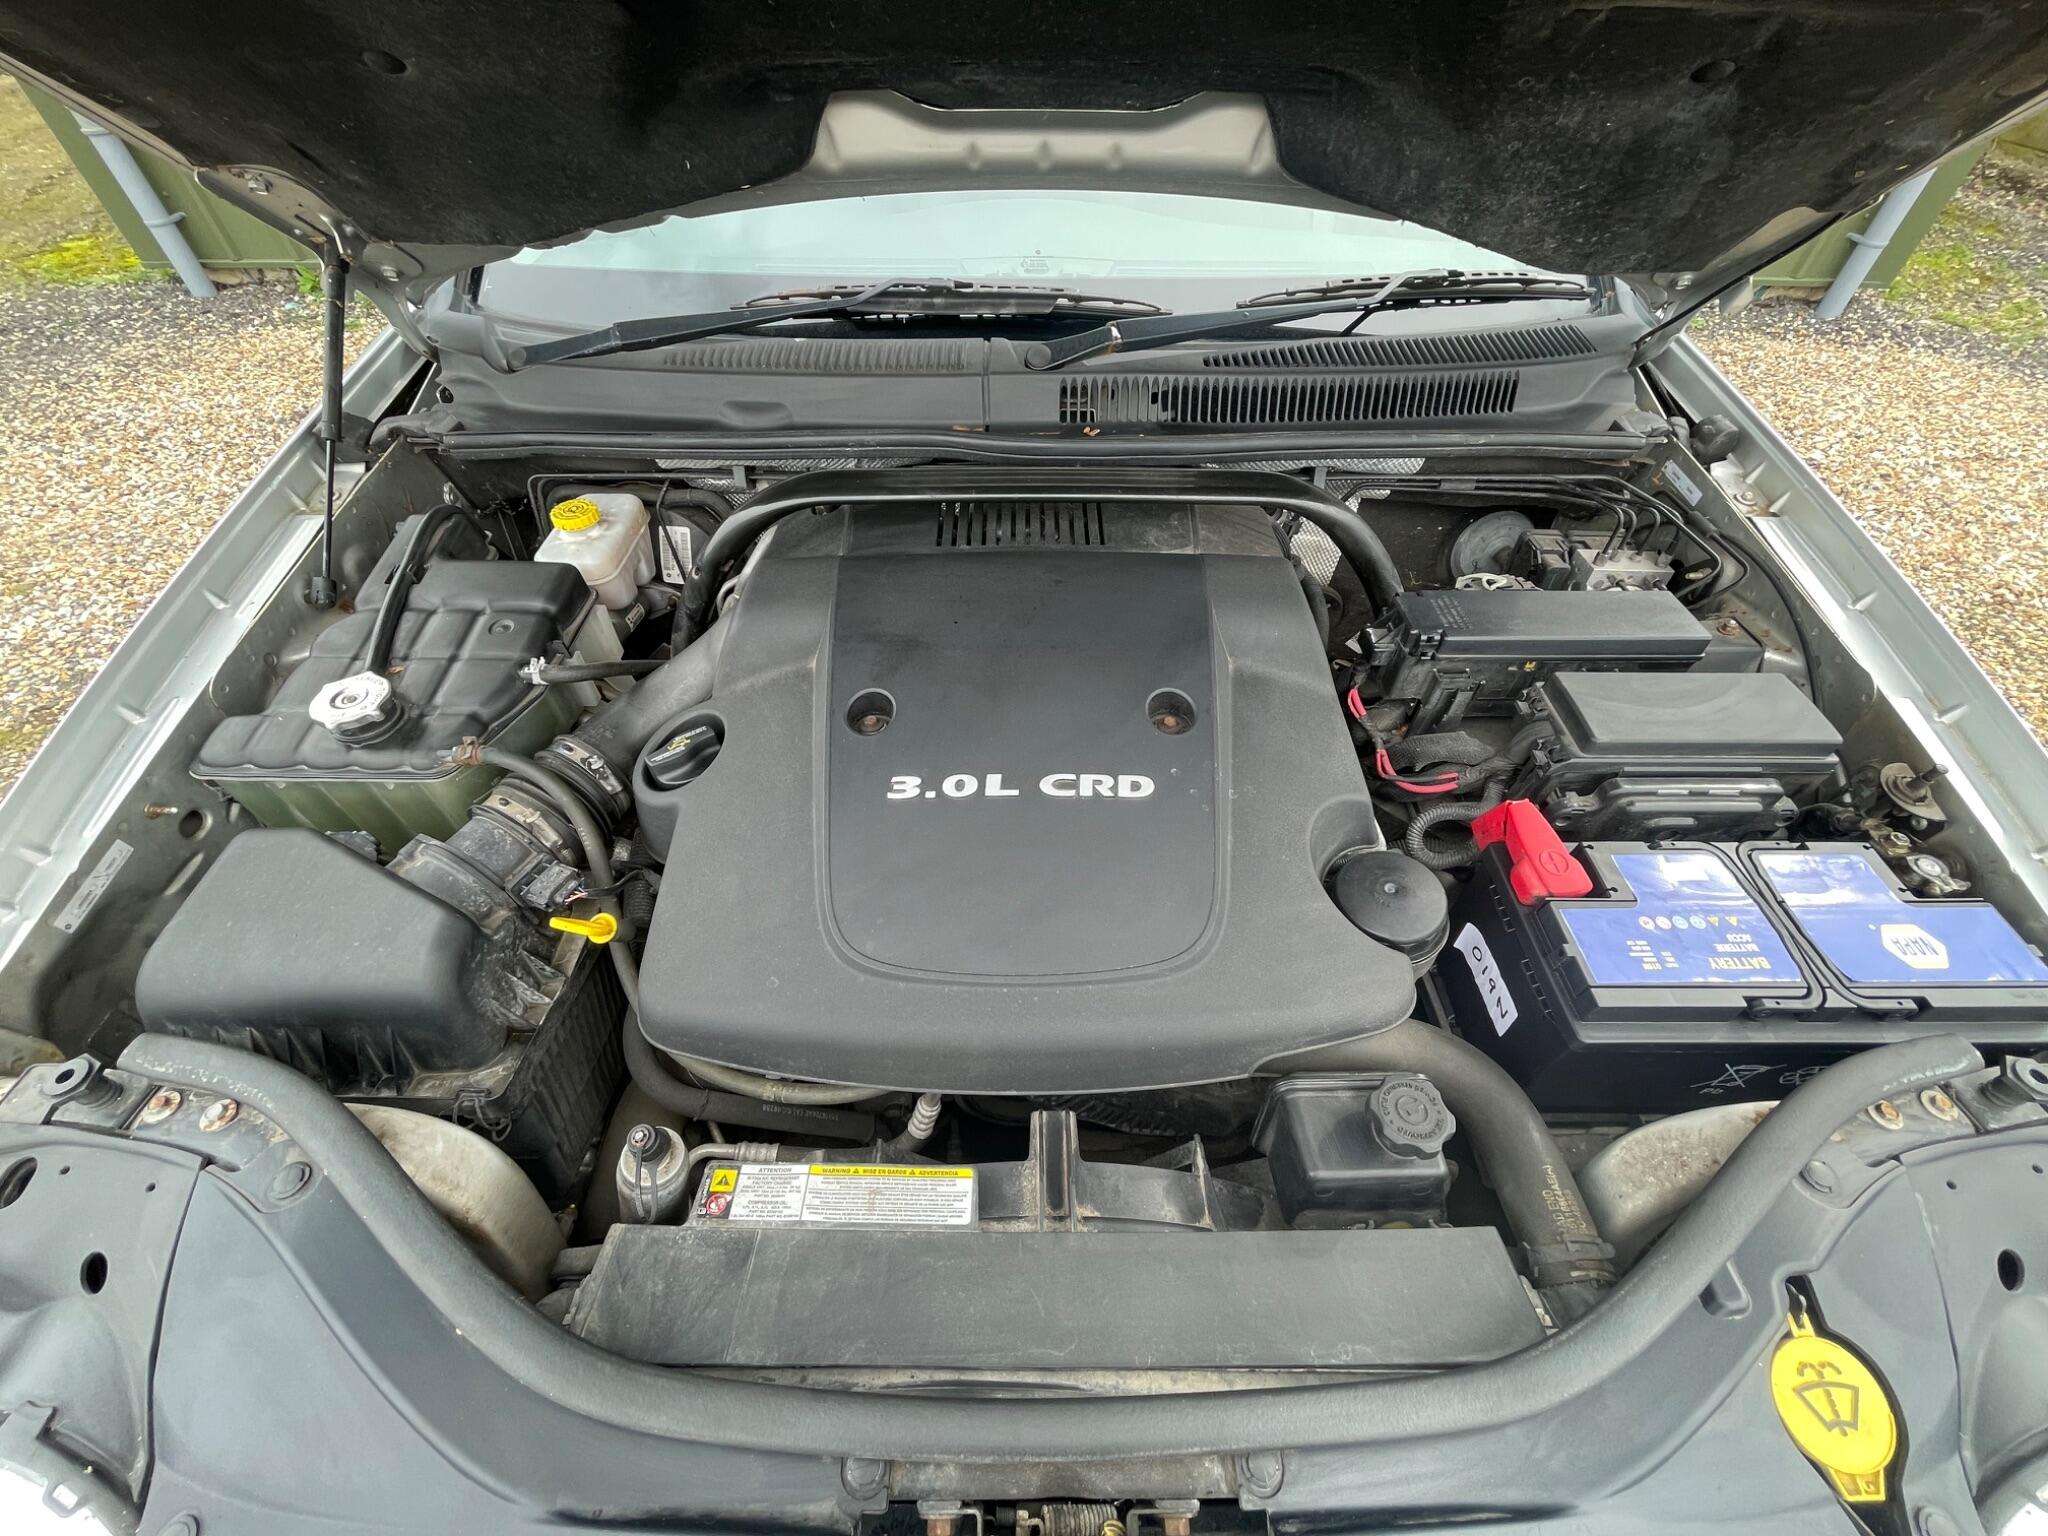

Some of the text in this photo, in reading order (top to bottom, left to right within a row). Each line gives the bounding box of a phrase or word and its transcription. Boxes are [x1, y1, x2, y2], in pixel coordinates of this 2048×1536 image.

[886, 773, 1156, 799] 3.0L CRD
[1890, 935, 1939, 956] NAPA
[1707, 956, 1772, 970] BATTERY
